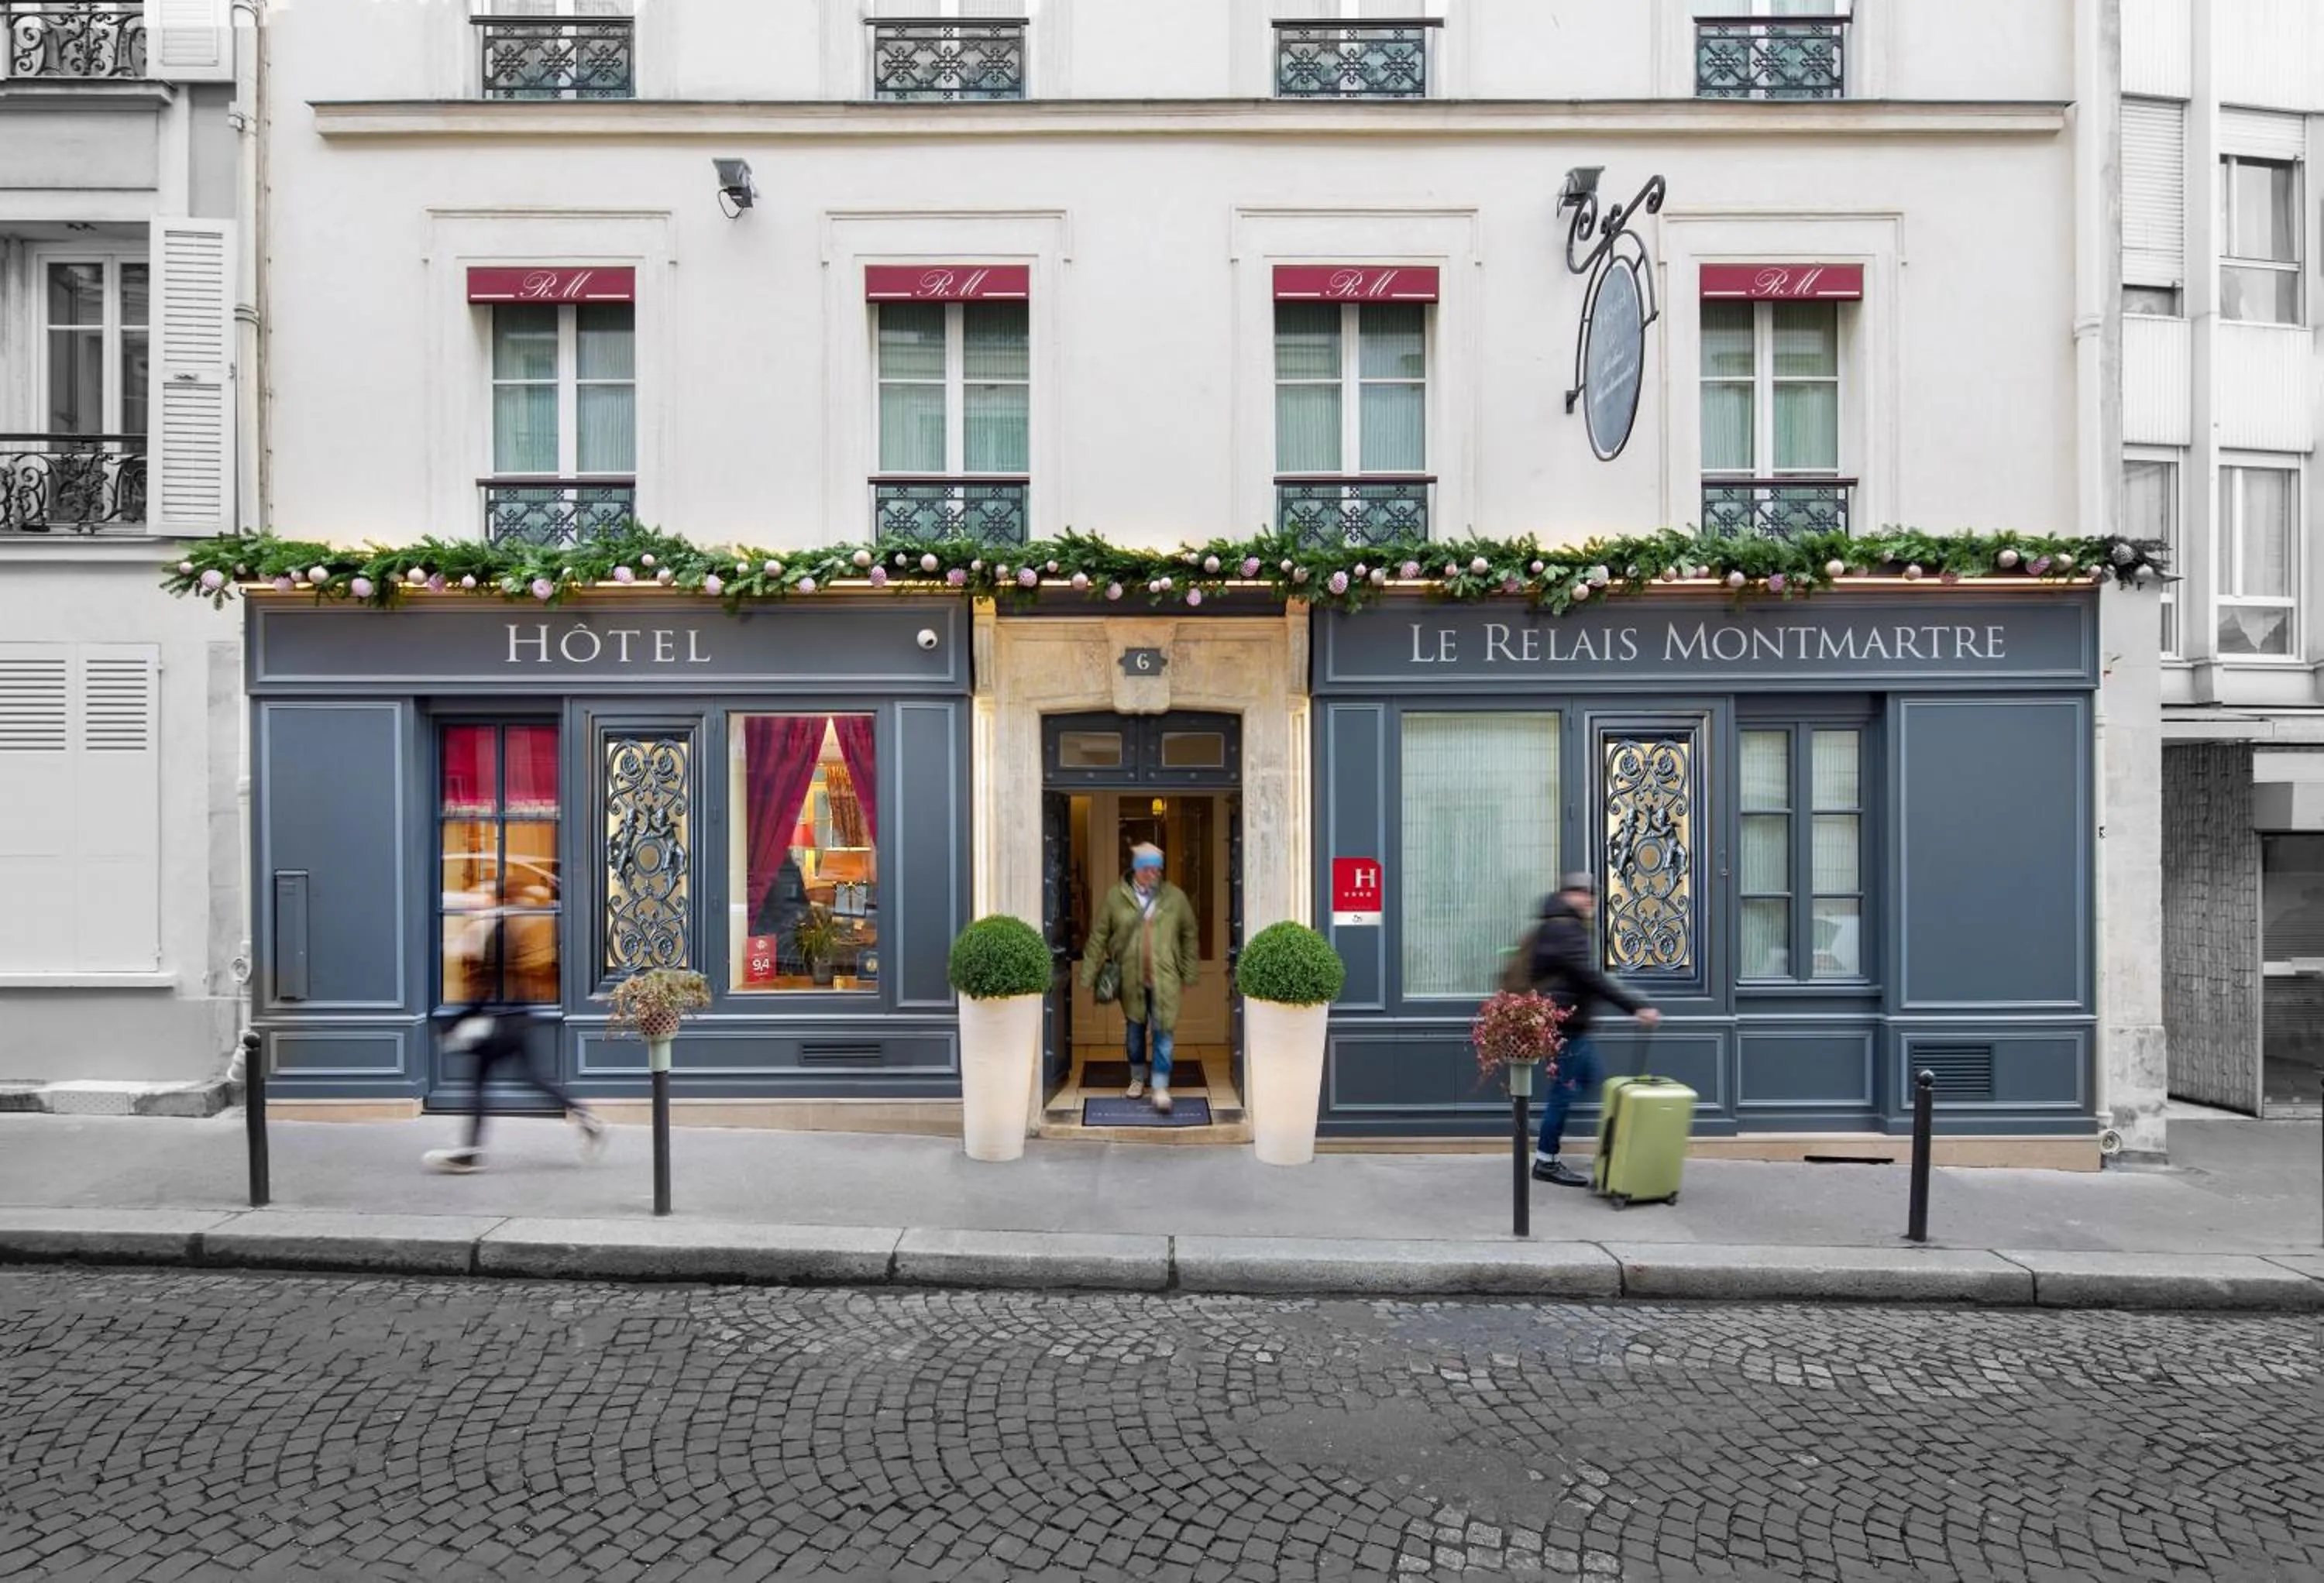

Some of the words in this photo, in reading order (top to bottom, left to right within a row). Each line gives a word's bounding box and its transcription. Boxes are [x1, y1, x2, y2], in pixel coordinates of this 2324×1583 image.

[504, 623, 711, 662] HÔTEL
[1409, 623, 1457, 662] LE
[1483, 623, 1638, 661] RELAIS
[1662, 621, 2006, 661] MONTMARTRE
[1136, 653, 1150, 670] 6
[1355, 868, 1376, 888] H
